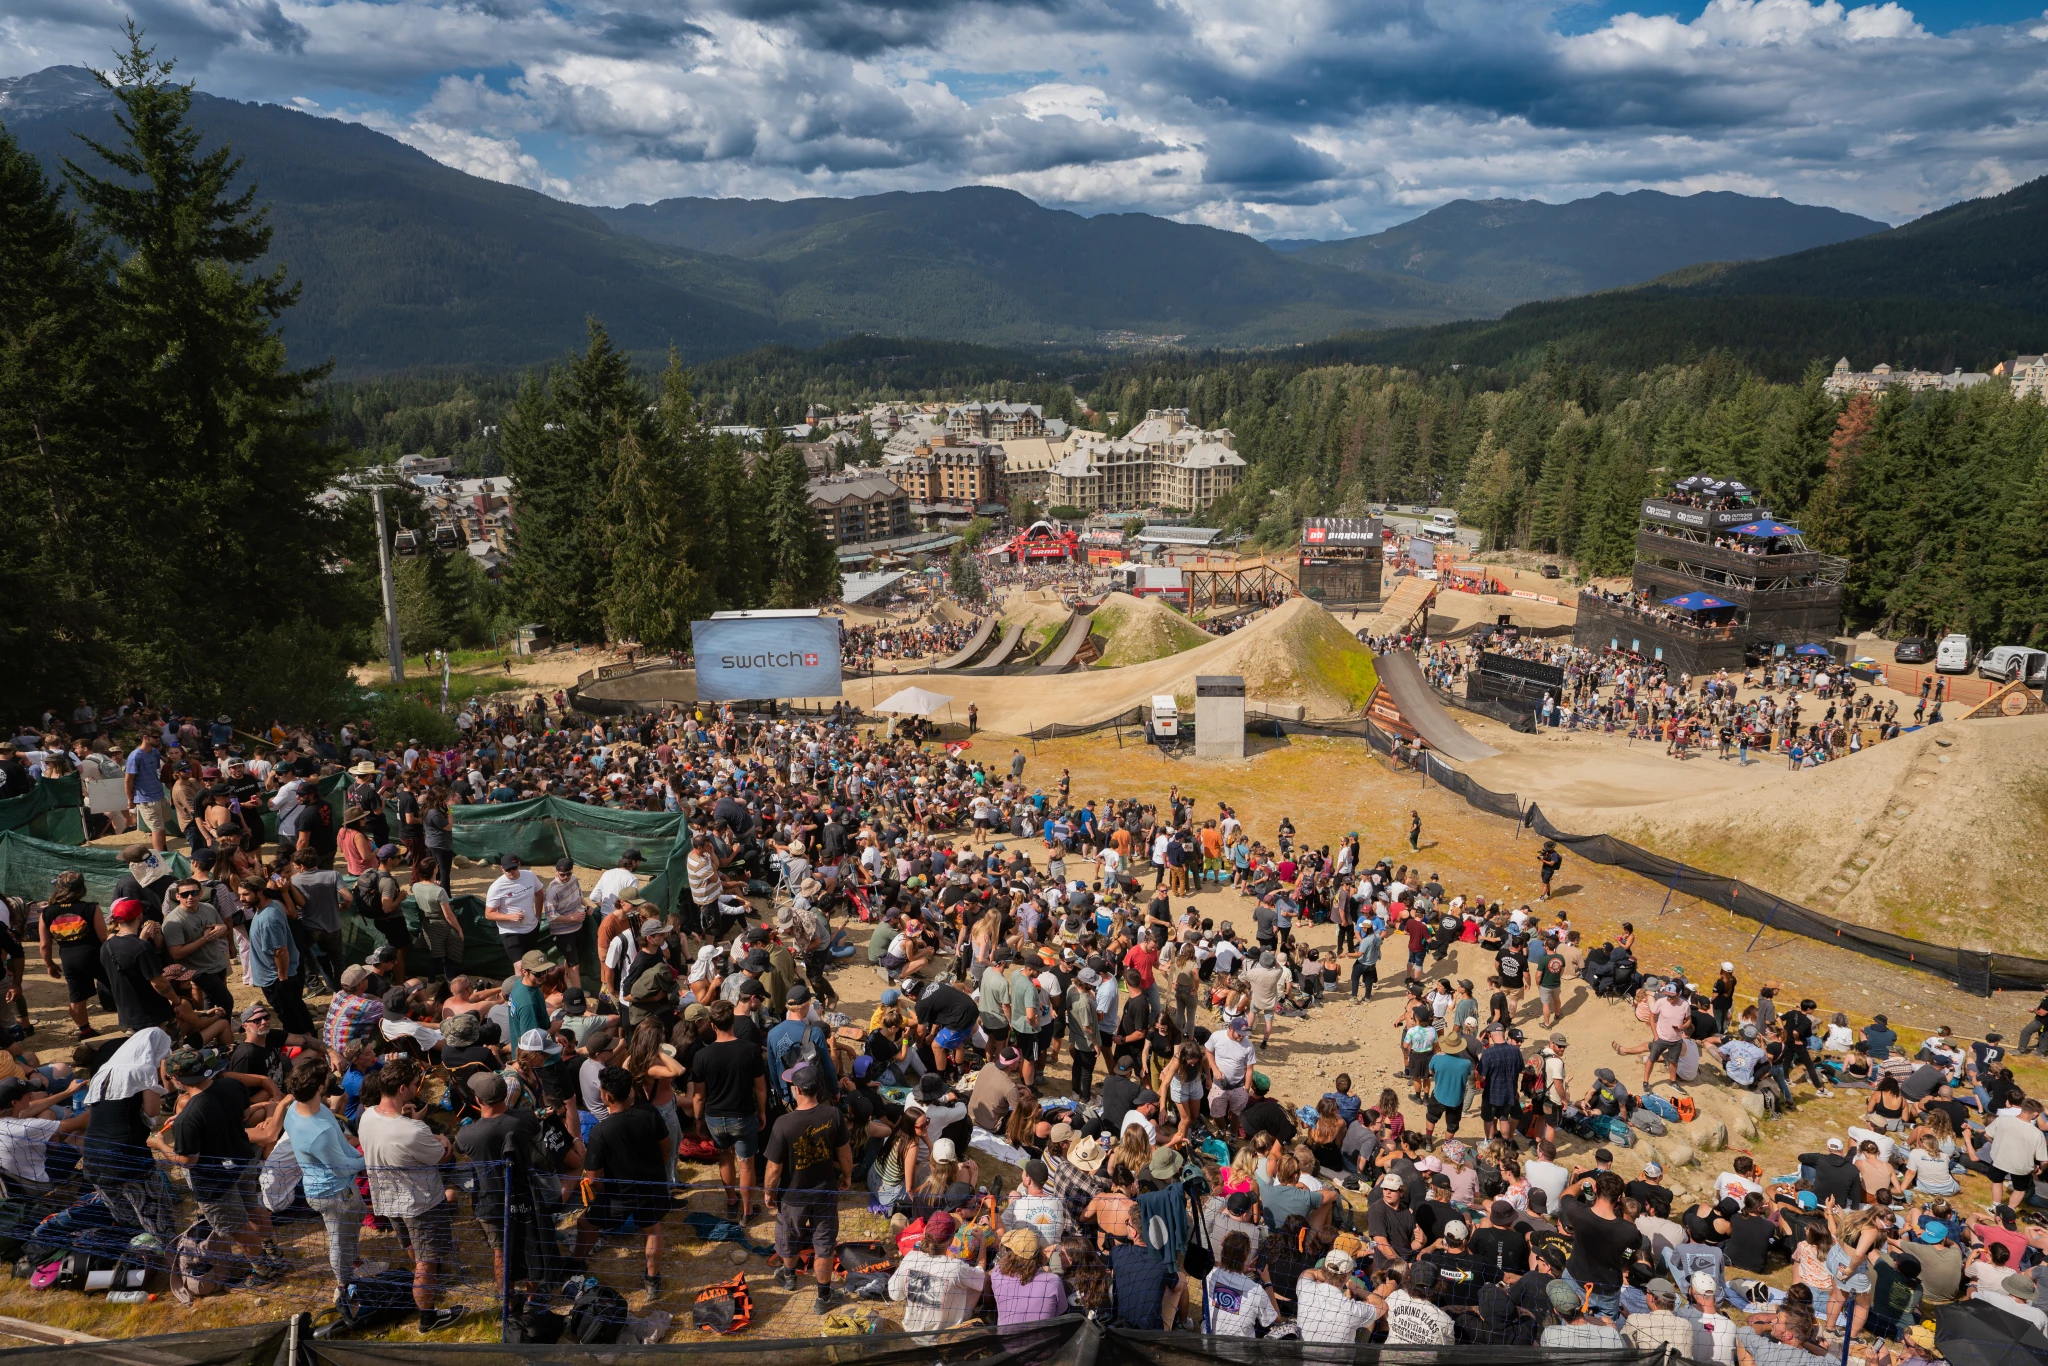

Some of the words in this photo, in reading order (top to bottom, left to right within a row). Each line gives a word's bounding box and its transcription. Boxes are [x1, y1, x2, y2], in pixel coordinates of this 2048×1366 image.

[1646, 506, 1655, 515] OR
[1677, 512, 1686, 521] OR
[1719, 514, 1731, 522] OR
[1328, 532, 1374, 540] pinkbike
[721, 651, 803, 669] swatch
[1398, 1318, 1430, 1336] PROVISIONS
[1420, 1312, 1440, 1334] CLASS
